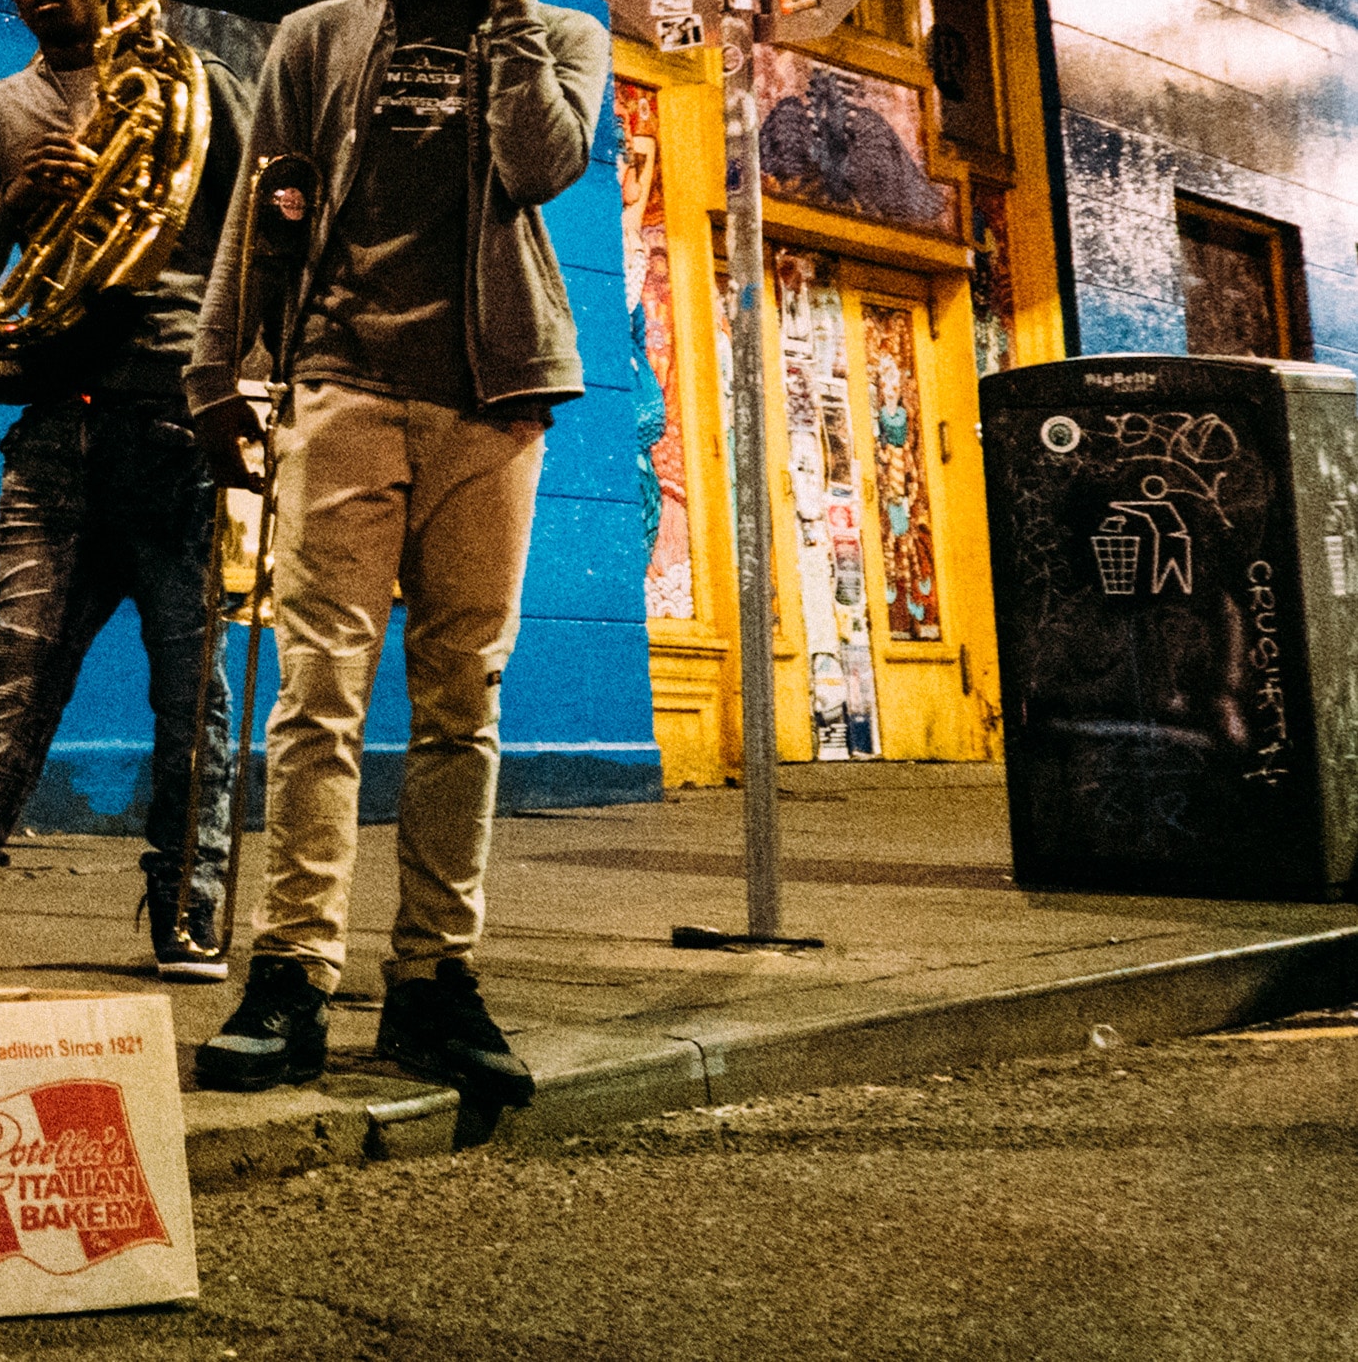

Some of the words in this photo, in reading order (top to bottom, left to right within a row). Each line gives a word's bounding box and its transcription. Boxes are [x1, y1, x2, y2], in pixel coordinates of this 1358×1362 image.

[58, 1038, 104, 1057] Since
[108, 1035, 145, 1055] 1921
[18, 1168, 140, 1200] ITALIAN
[19, 1198, 147, 1231] BAKERY
